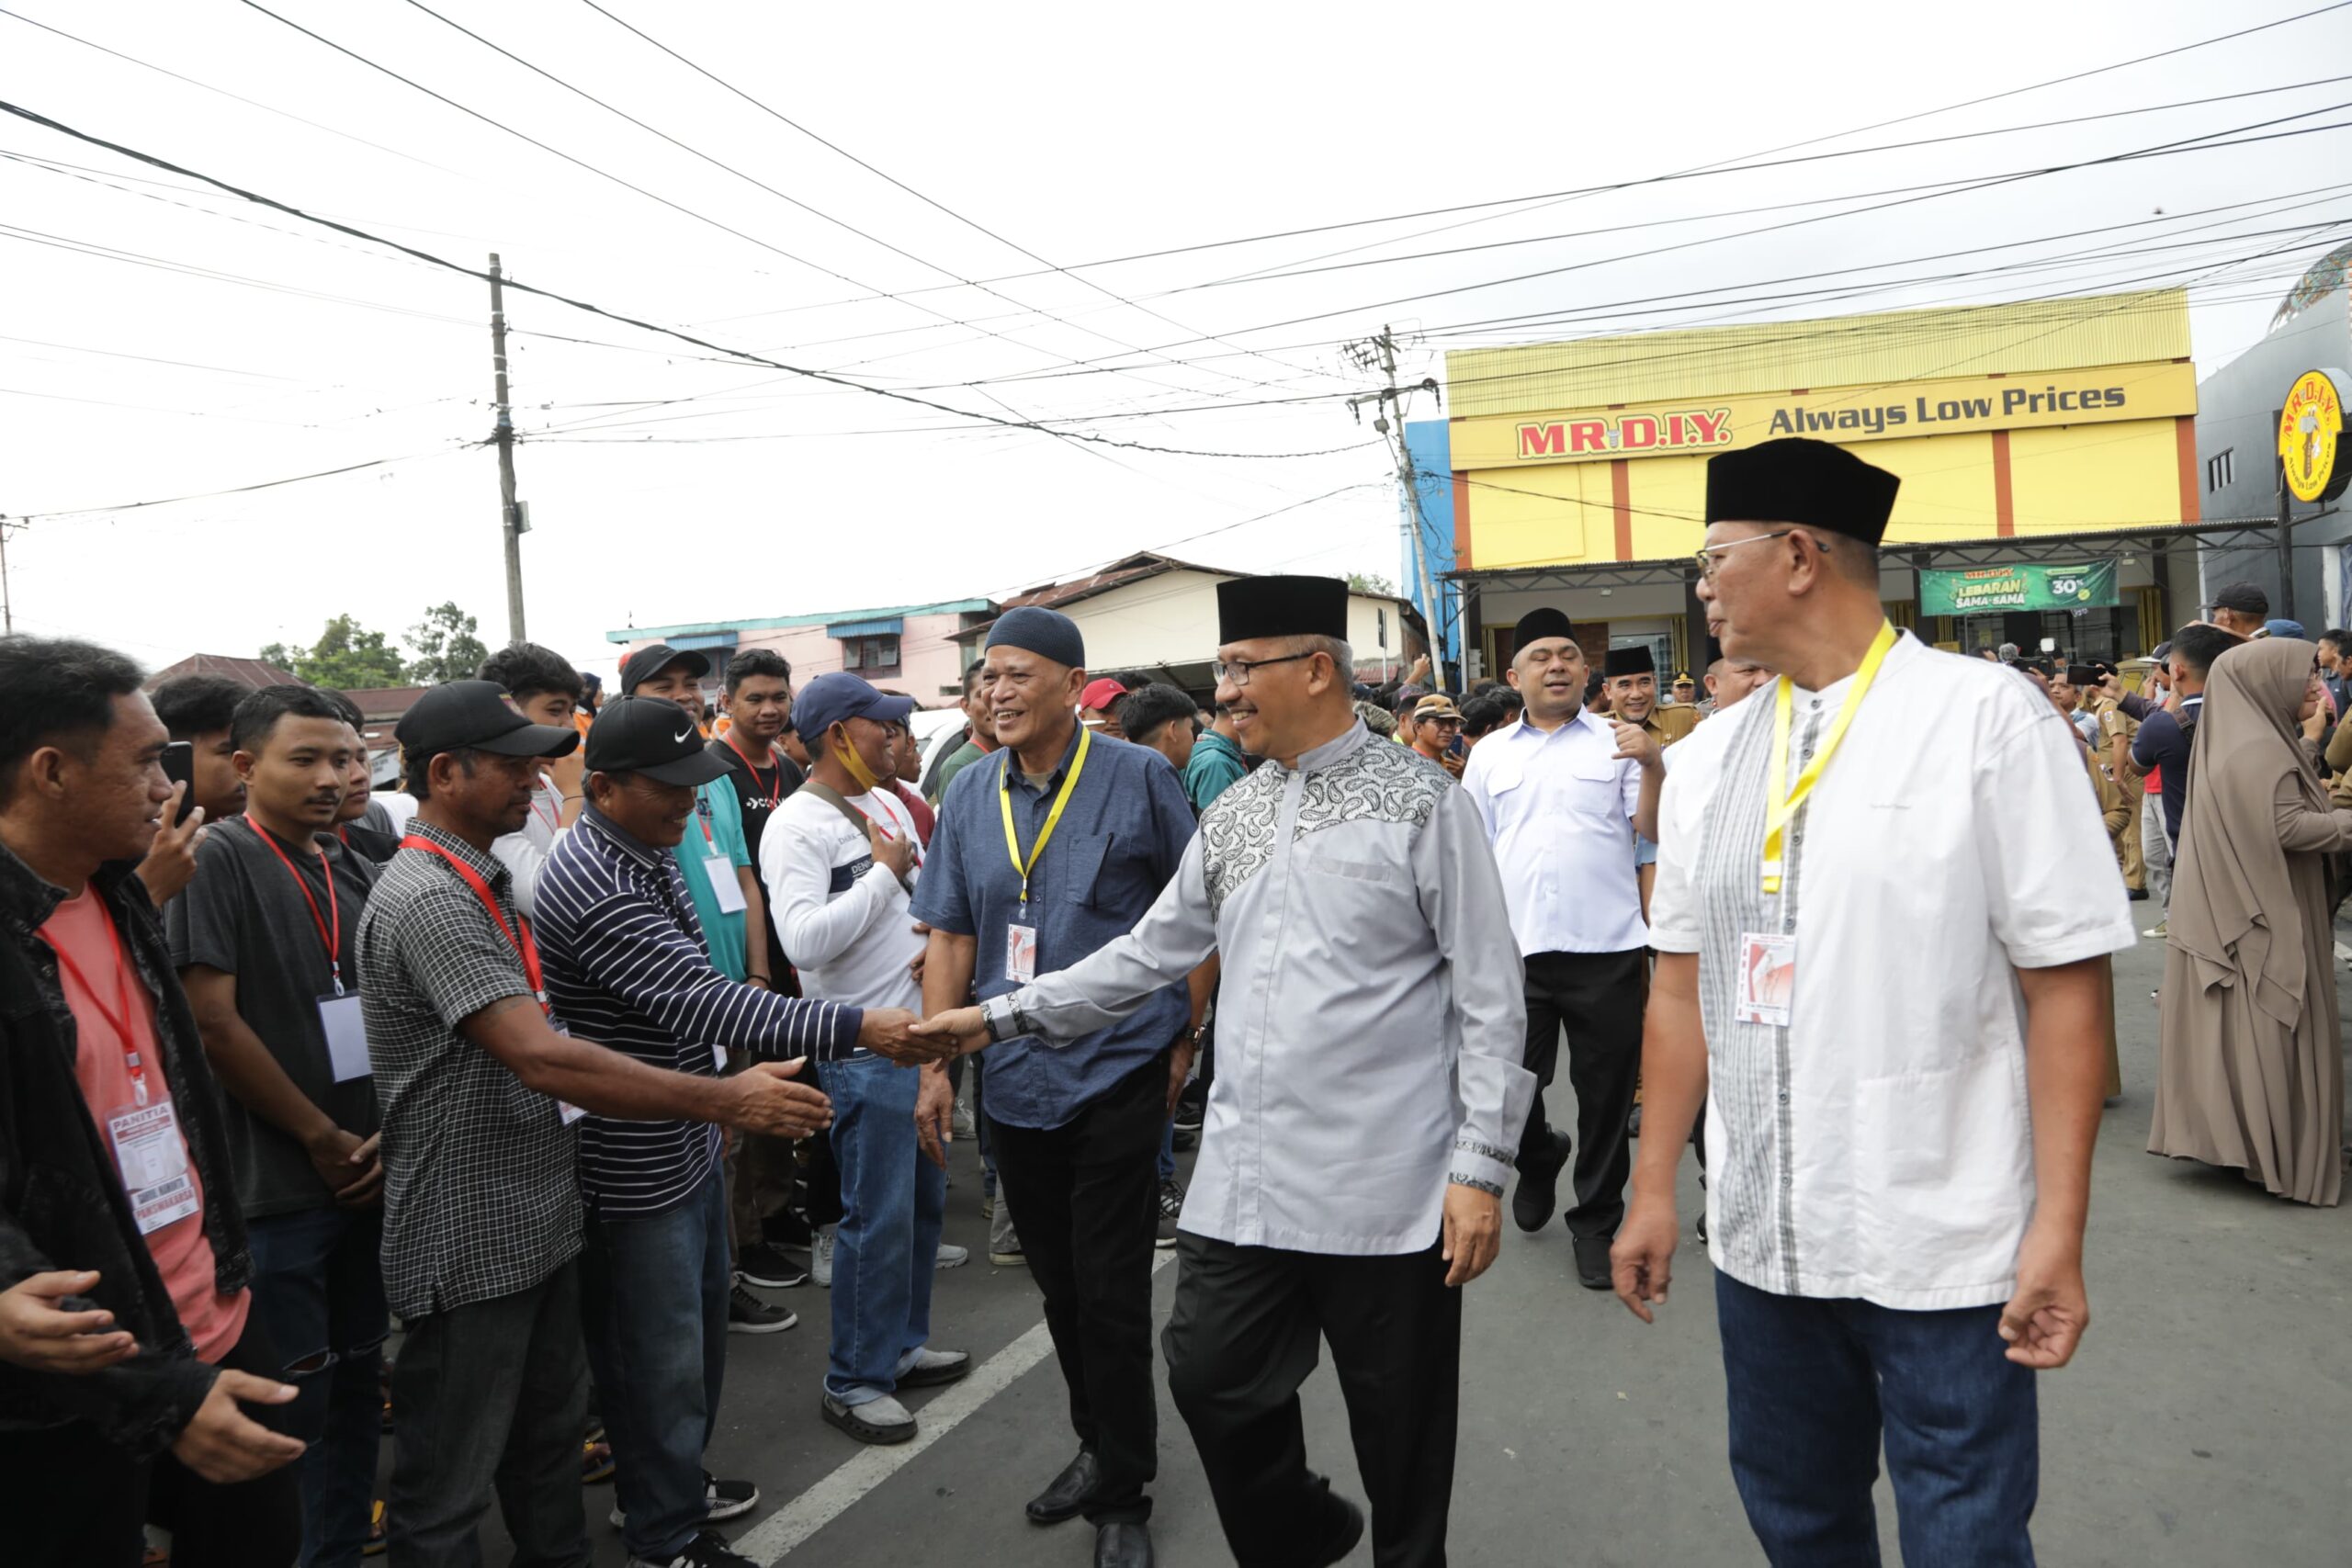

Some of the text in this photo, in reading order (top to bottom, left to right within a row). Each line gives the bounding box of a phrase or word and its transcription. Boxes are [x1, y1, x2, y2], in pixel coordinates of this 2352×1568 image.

[1768, 385, 2126, 435] Always Low Prices
[1958, 579, 2021, 598] LEBARAN
[2052, 579, 2085, 595] 30%
[113, 1105, 169, 1131] PANITIA
